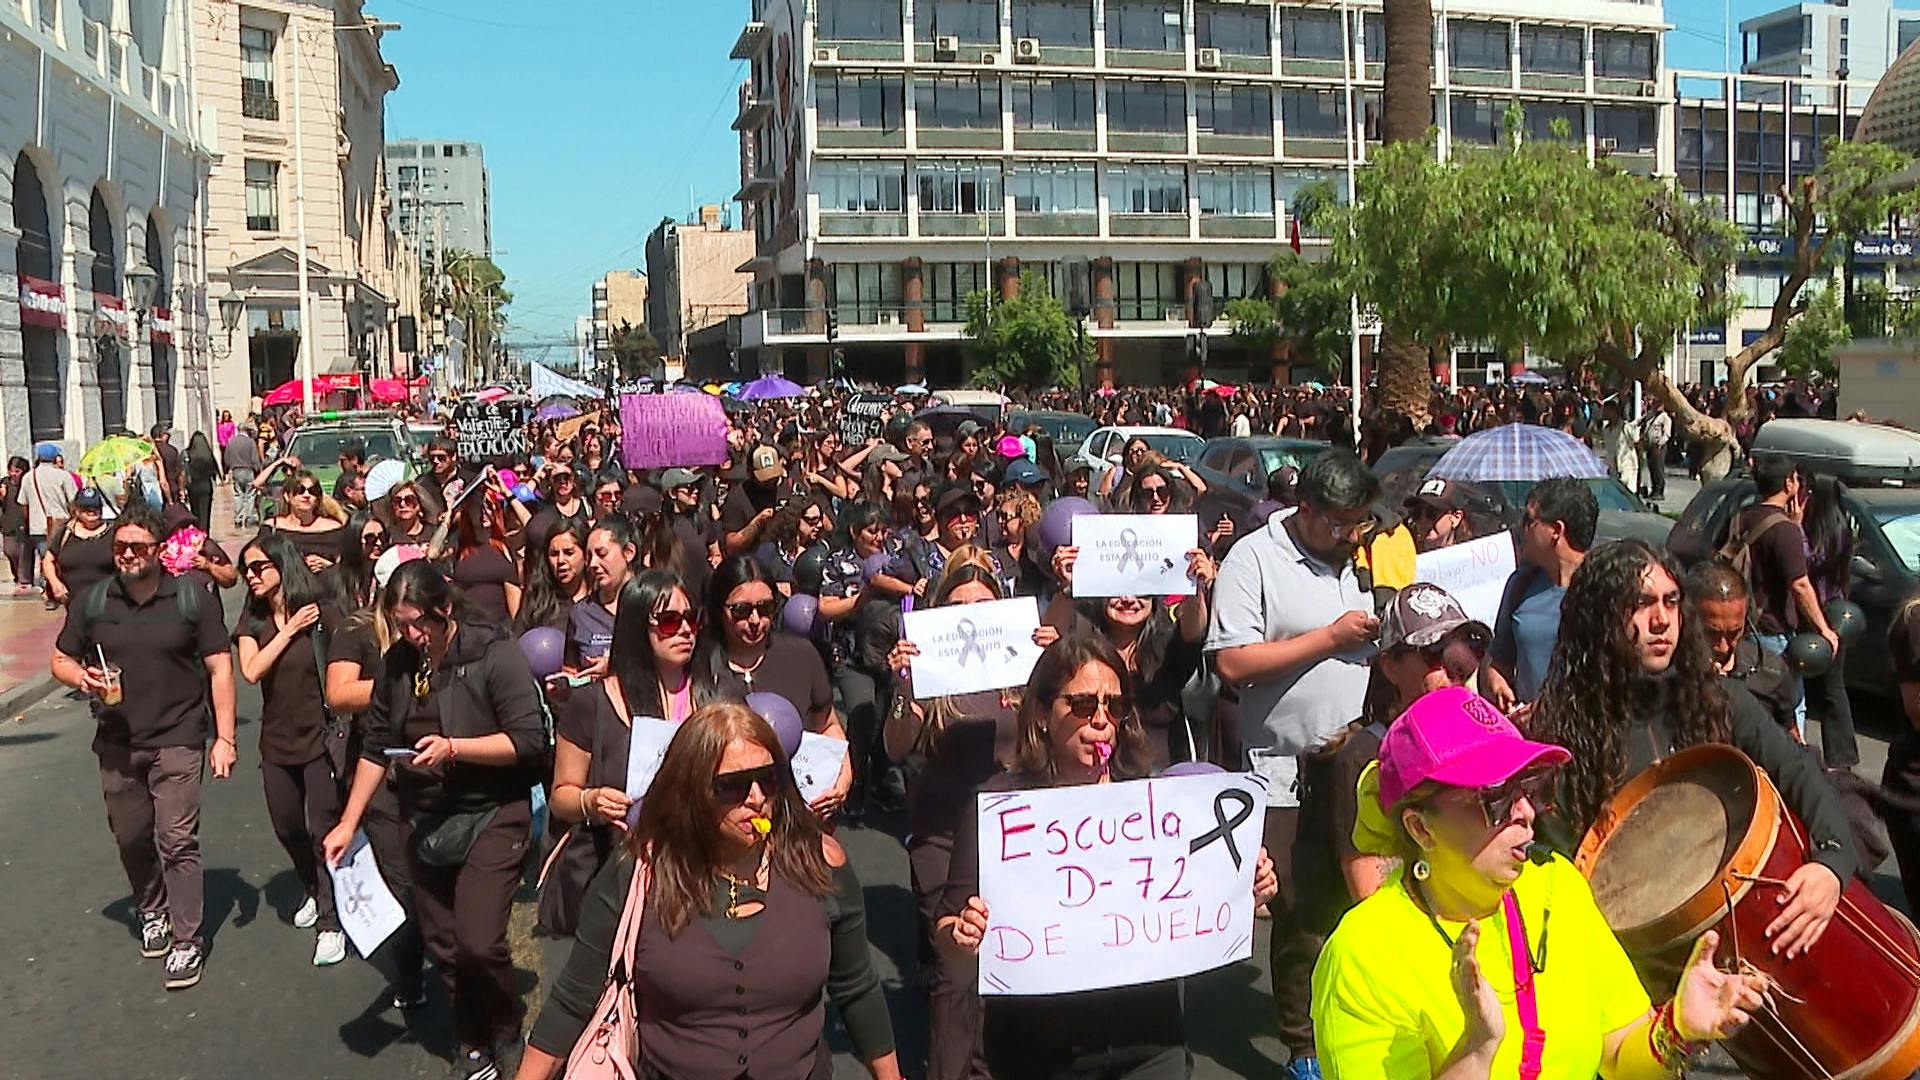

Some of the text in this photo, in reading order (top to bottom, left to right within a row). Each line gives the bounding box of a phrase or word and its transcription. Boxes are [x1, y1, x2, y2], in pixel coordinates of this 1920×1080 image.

[1471, 541, 1499, 568] NO
[997, 782, 1182, 862] Escuela
[991, 902, 1232, 962] DE DUELO
